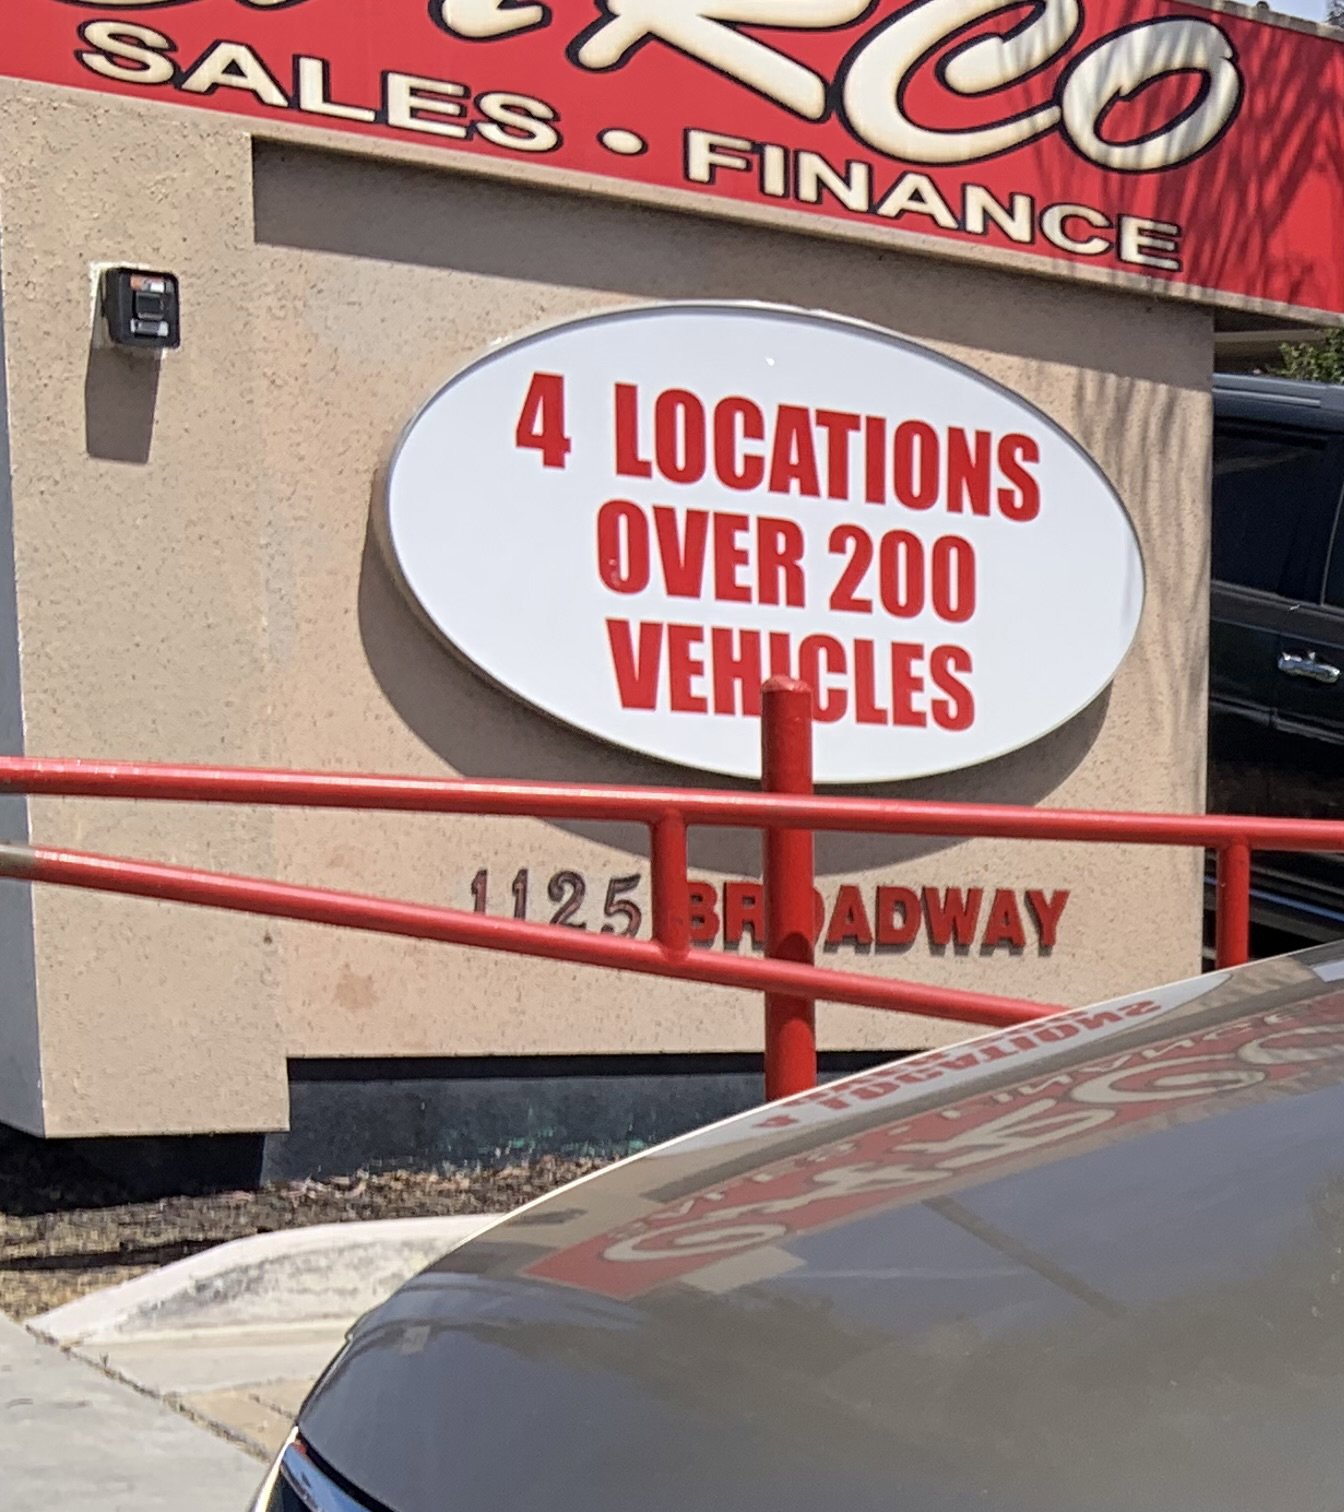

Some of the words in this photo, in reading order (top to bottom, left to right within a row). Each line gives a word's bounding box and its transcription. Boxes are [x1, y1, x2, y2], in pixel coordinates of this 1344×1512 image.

[75, 18, 562, 153] SALES
[683, 127, 1184, 272] FINANCE
[514, 371, 572, 470] 4
[612, 381, 1042, 523] LOCATIONS
[595, 498, 807, 610] OVER
[827, 524, 977, 624] 200
[470, 868, 642, 939] 1125
[686, 880, 1071, 952] BRADWAY
